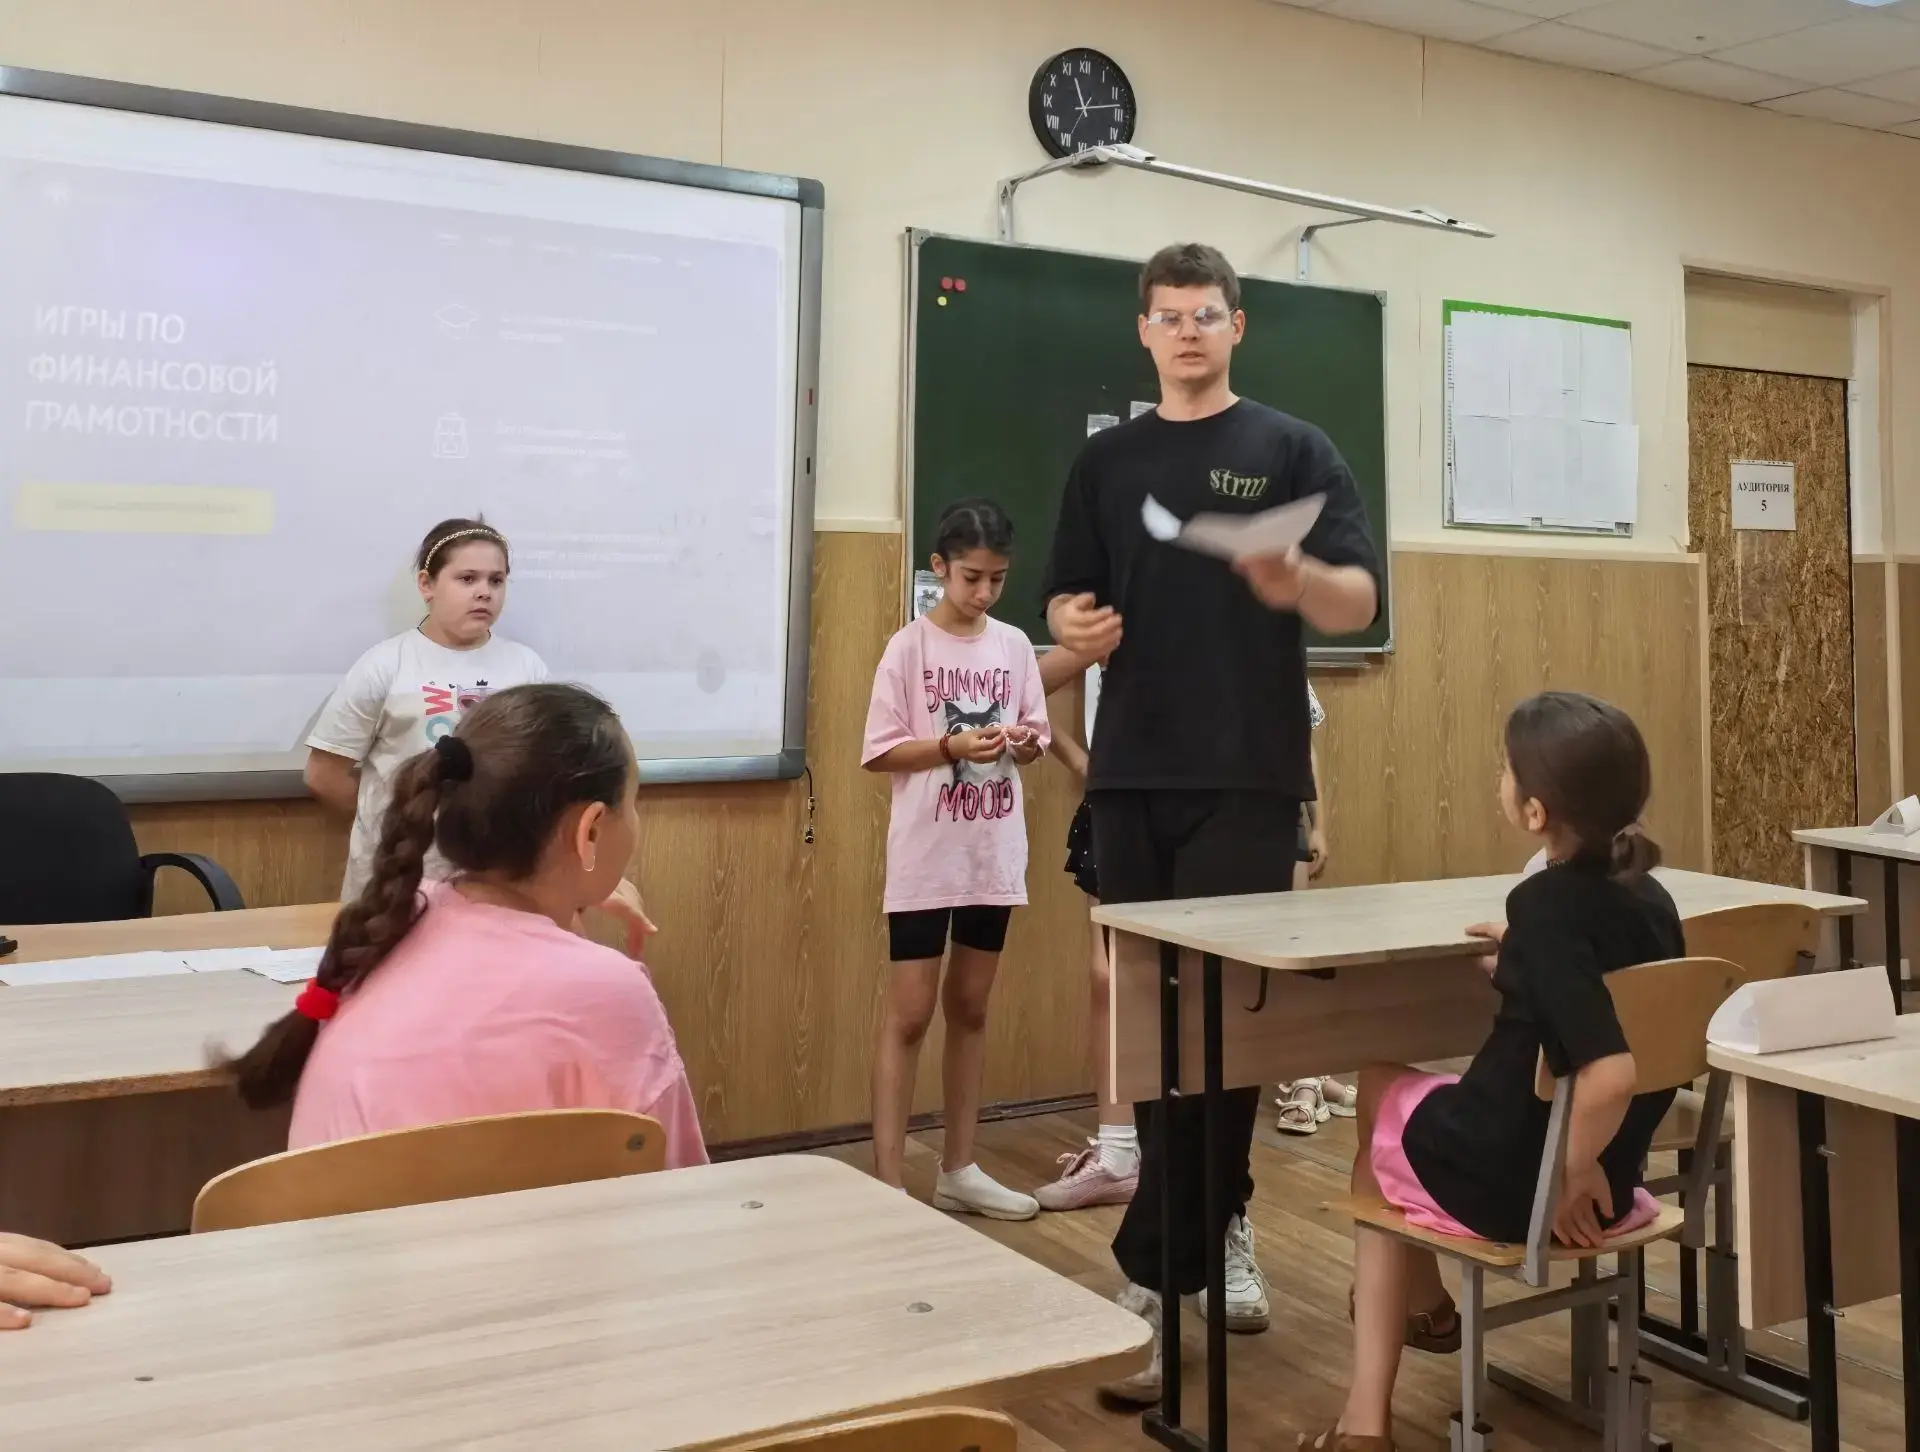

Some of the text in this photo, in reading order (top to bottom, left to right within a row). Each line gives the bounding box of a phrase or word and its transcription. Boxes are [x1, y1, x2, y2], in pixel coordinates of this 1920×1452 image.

[1062, 61, 1072, 76] XI
[1079, 60, 1091, 76] XII
[1050, 73, 1057, 87] X
[1043, 93, 1053, 108] IX
[1111, 86, 1119, 101] II
[1046, 114, 1060, 130] VIII
[1114, 108, 1124, 122] III
[1060, 132, 1072, 148] VII
[1110, 126, 1119, 141] IV
[35, 303, 186, 344] ИГРЫ ПО
[28, 351, 280, 397] ФИНАНСОВОЙ
[25, 399, 280, 443] ГРАМОТНОСТИ
[1736, 482, 1790, 493] АУДИТОРИЯ
[1760, 499, 1767, 512] 5
[935, 776, 1014, 823] MOOD
